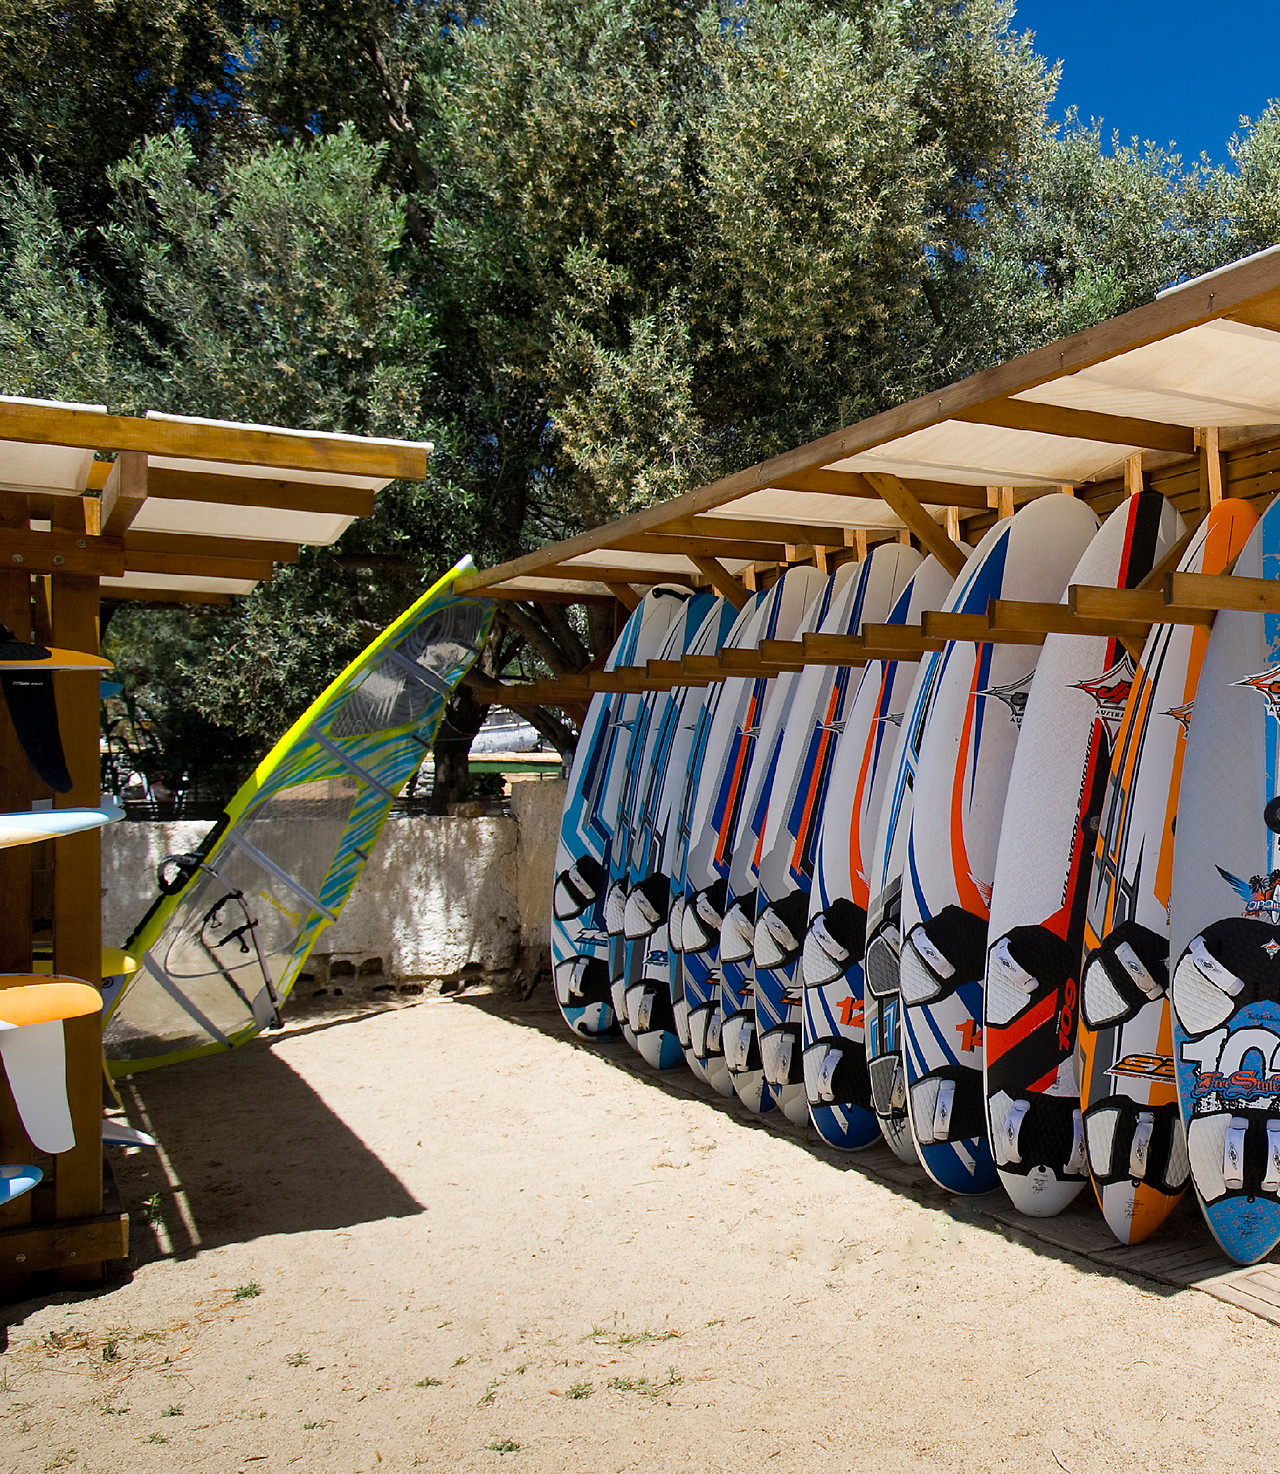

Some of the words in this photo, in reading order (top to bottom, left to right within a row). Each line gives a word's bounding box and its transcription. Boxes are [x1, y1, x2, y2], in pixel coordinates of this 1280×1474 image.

[1060, 870, 1070, 907] FULL
[1067, 813, 1080, 863] WOOD
[1076, 721, 1095, 808] SANDWICH
[1059, 977, 1077, 1050] 109
